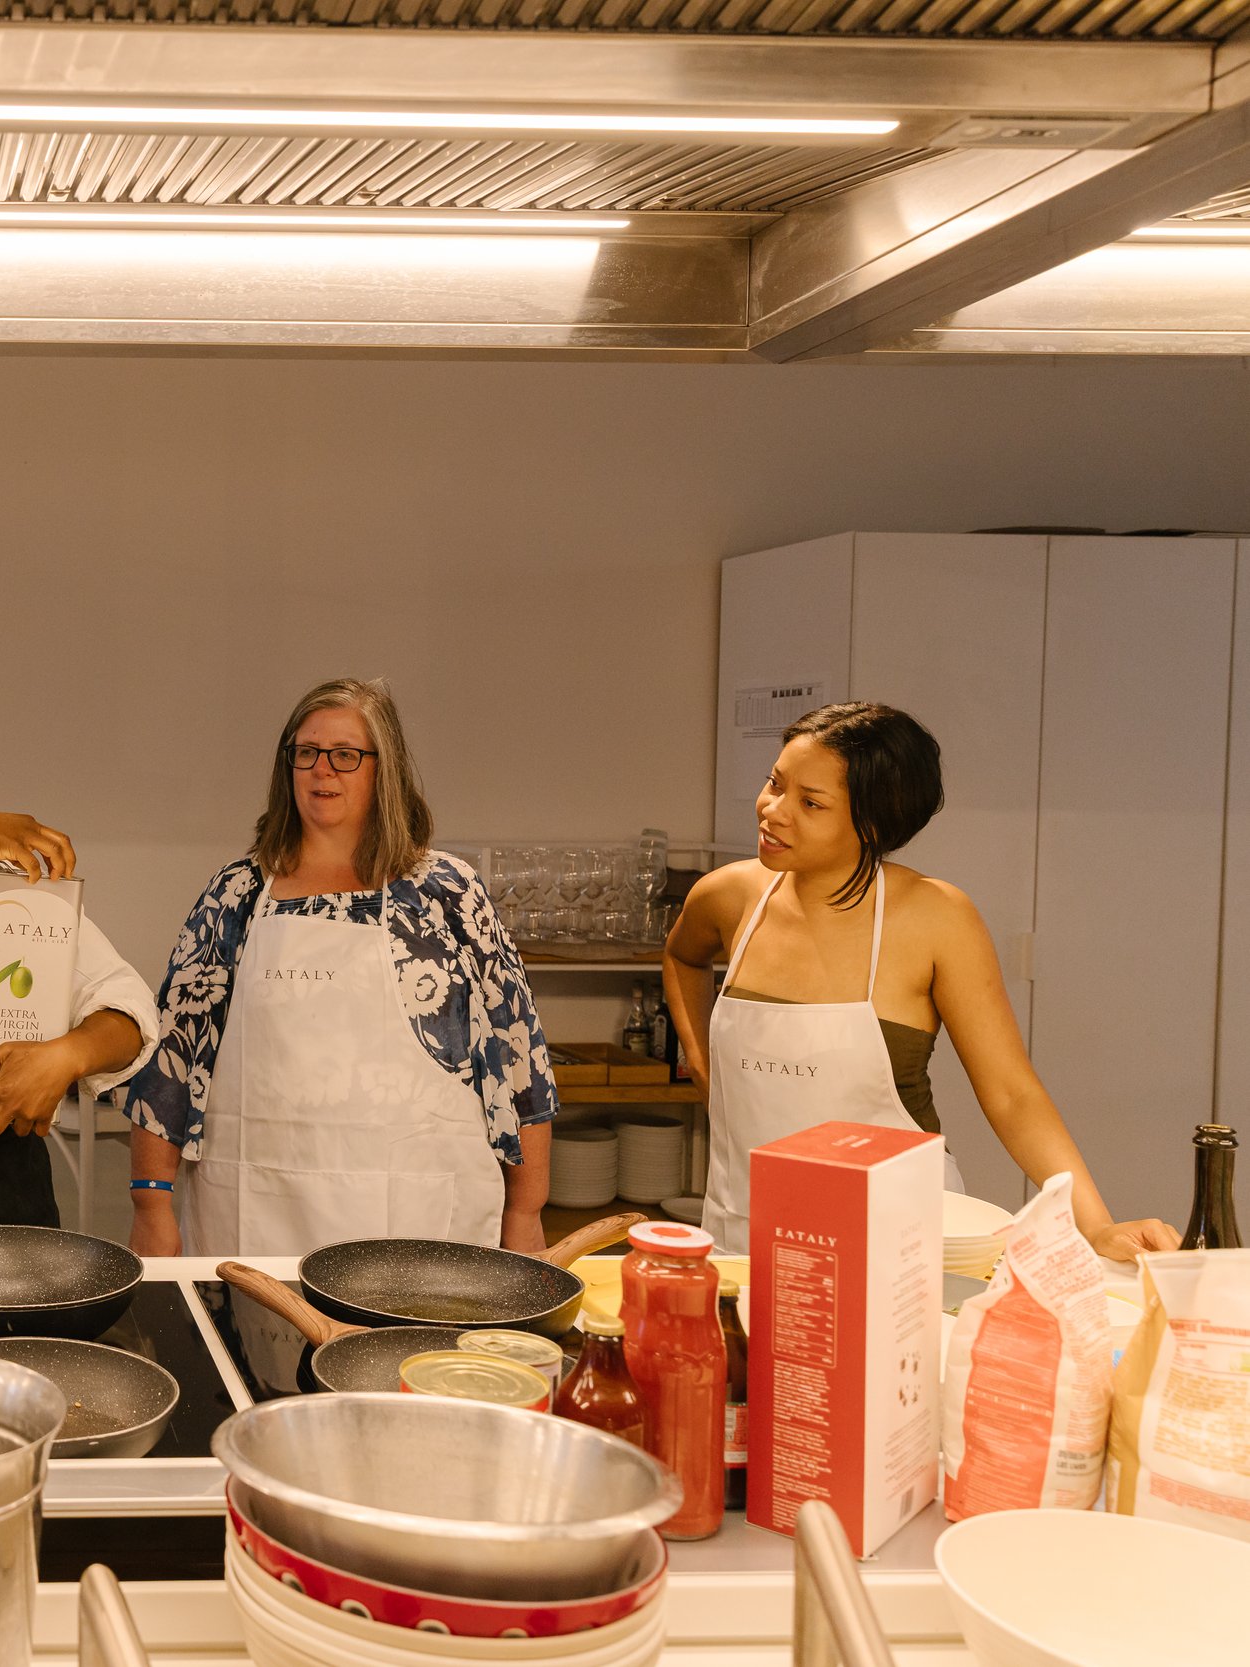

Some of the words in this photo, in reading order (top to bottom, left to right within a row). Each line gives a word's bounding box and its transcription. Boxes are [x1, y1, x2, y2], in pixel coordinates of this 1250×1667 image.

[264, 969, 335, 980] EATALY
[0, 1008, 37, 1019] EXTRA
[25, 1031, 46, 1042] OIL
[741, 1058, 818, 1077] EATALY
[775, 1227, 838, 1247] EATALY
